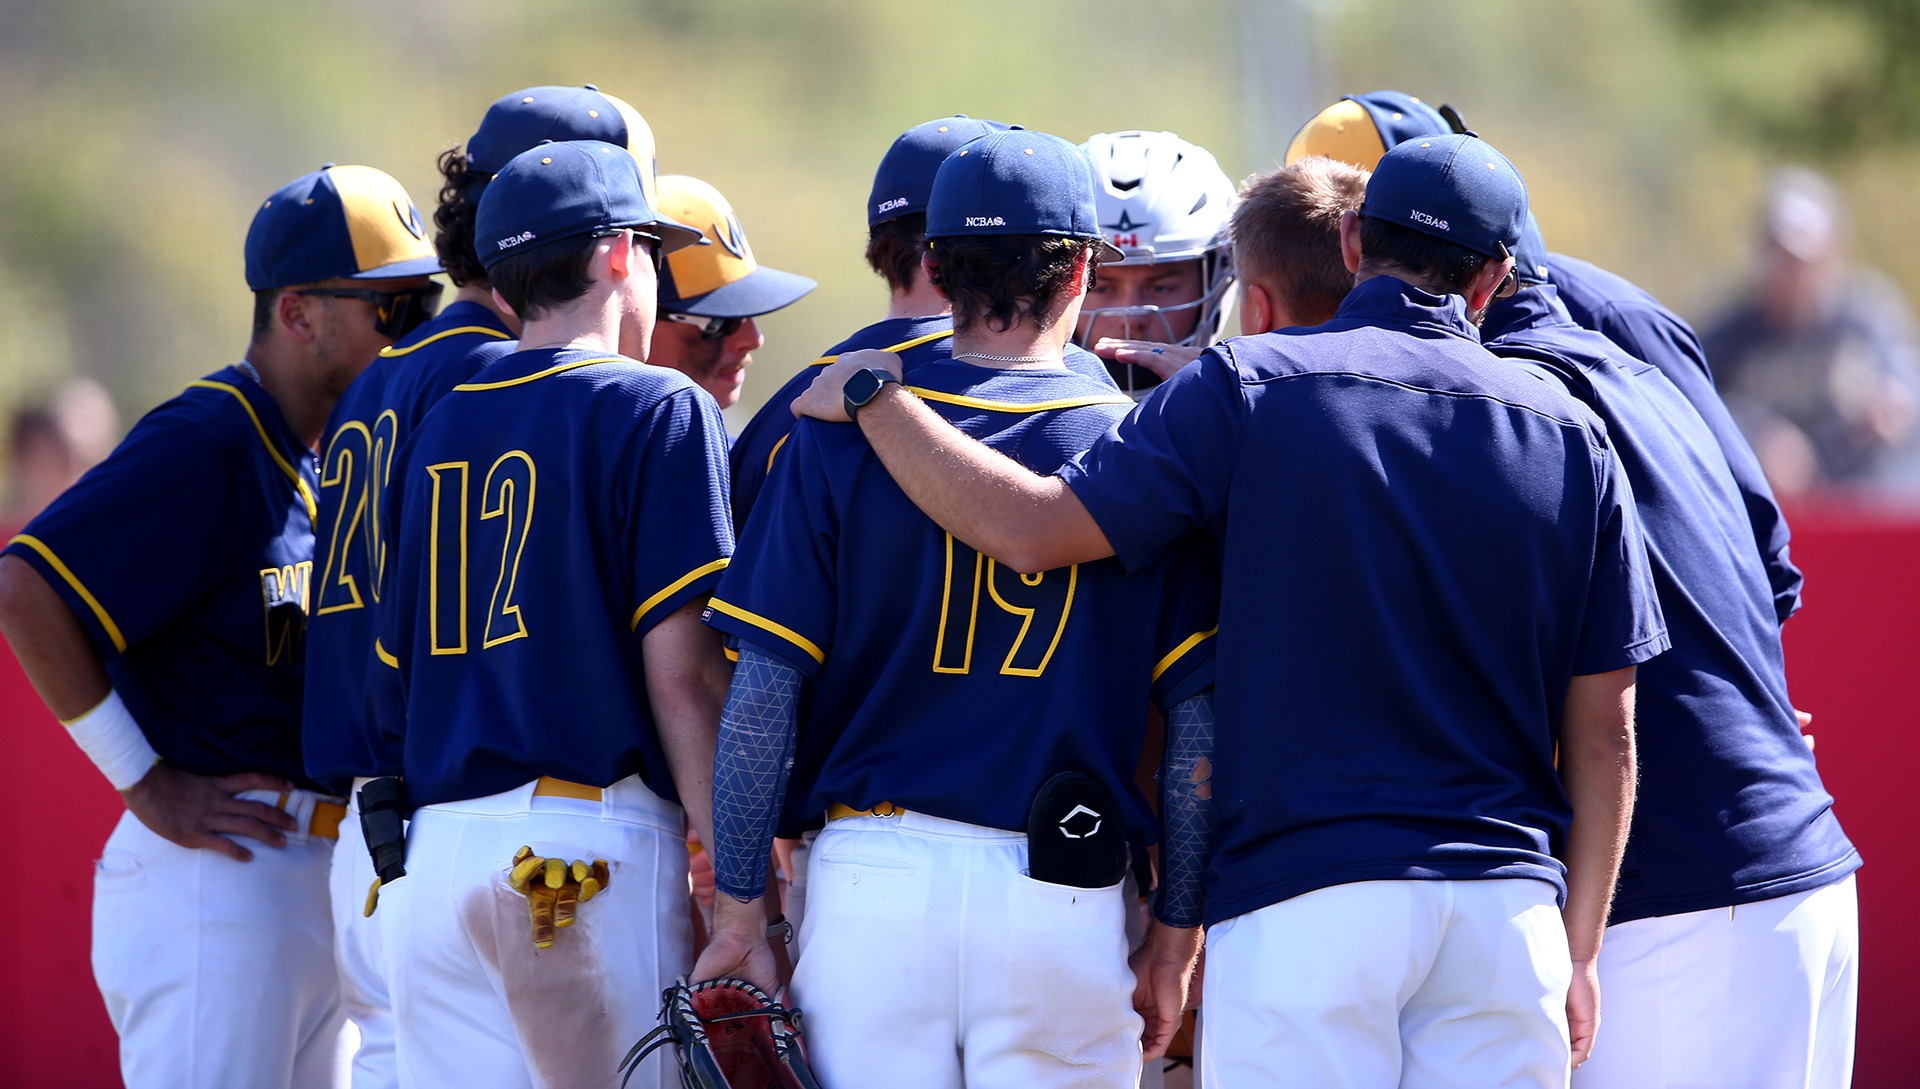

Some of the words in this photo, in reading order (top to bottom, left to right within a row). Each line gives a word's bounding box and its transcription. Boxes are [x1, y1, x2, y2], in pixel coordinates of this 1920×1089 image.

[878, 200, 900, 213] NCBA
[965, 217, 994, 226] NCBA
[1410, 210, 1440, 227] NCBA
[497, 235, 525, 250] NCBA
[426, 449, 537, 655] 12
[932, 531, 1078, 677] 19
